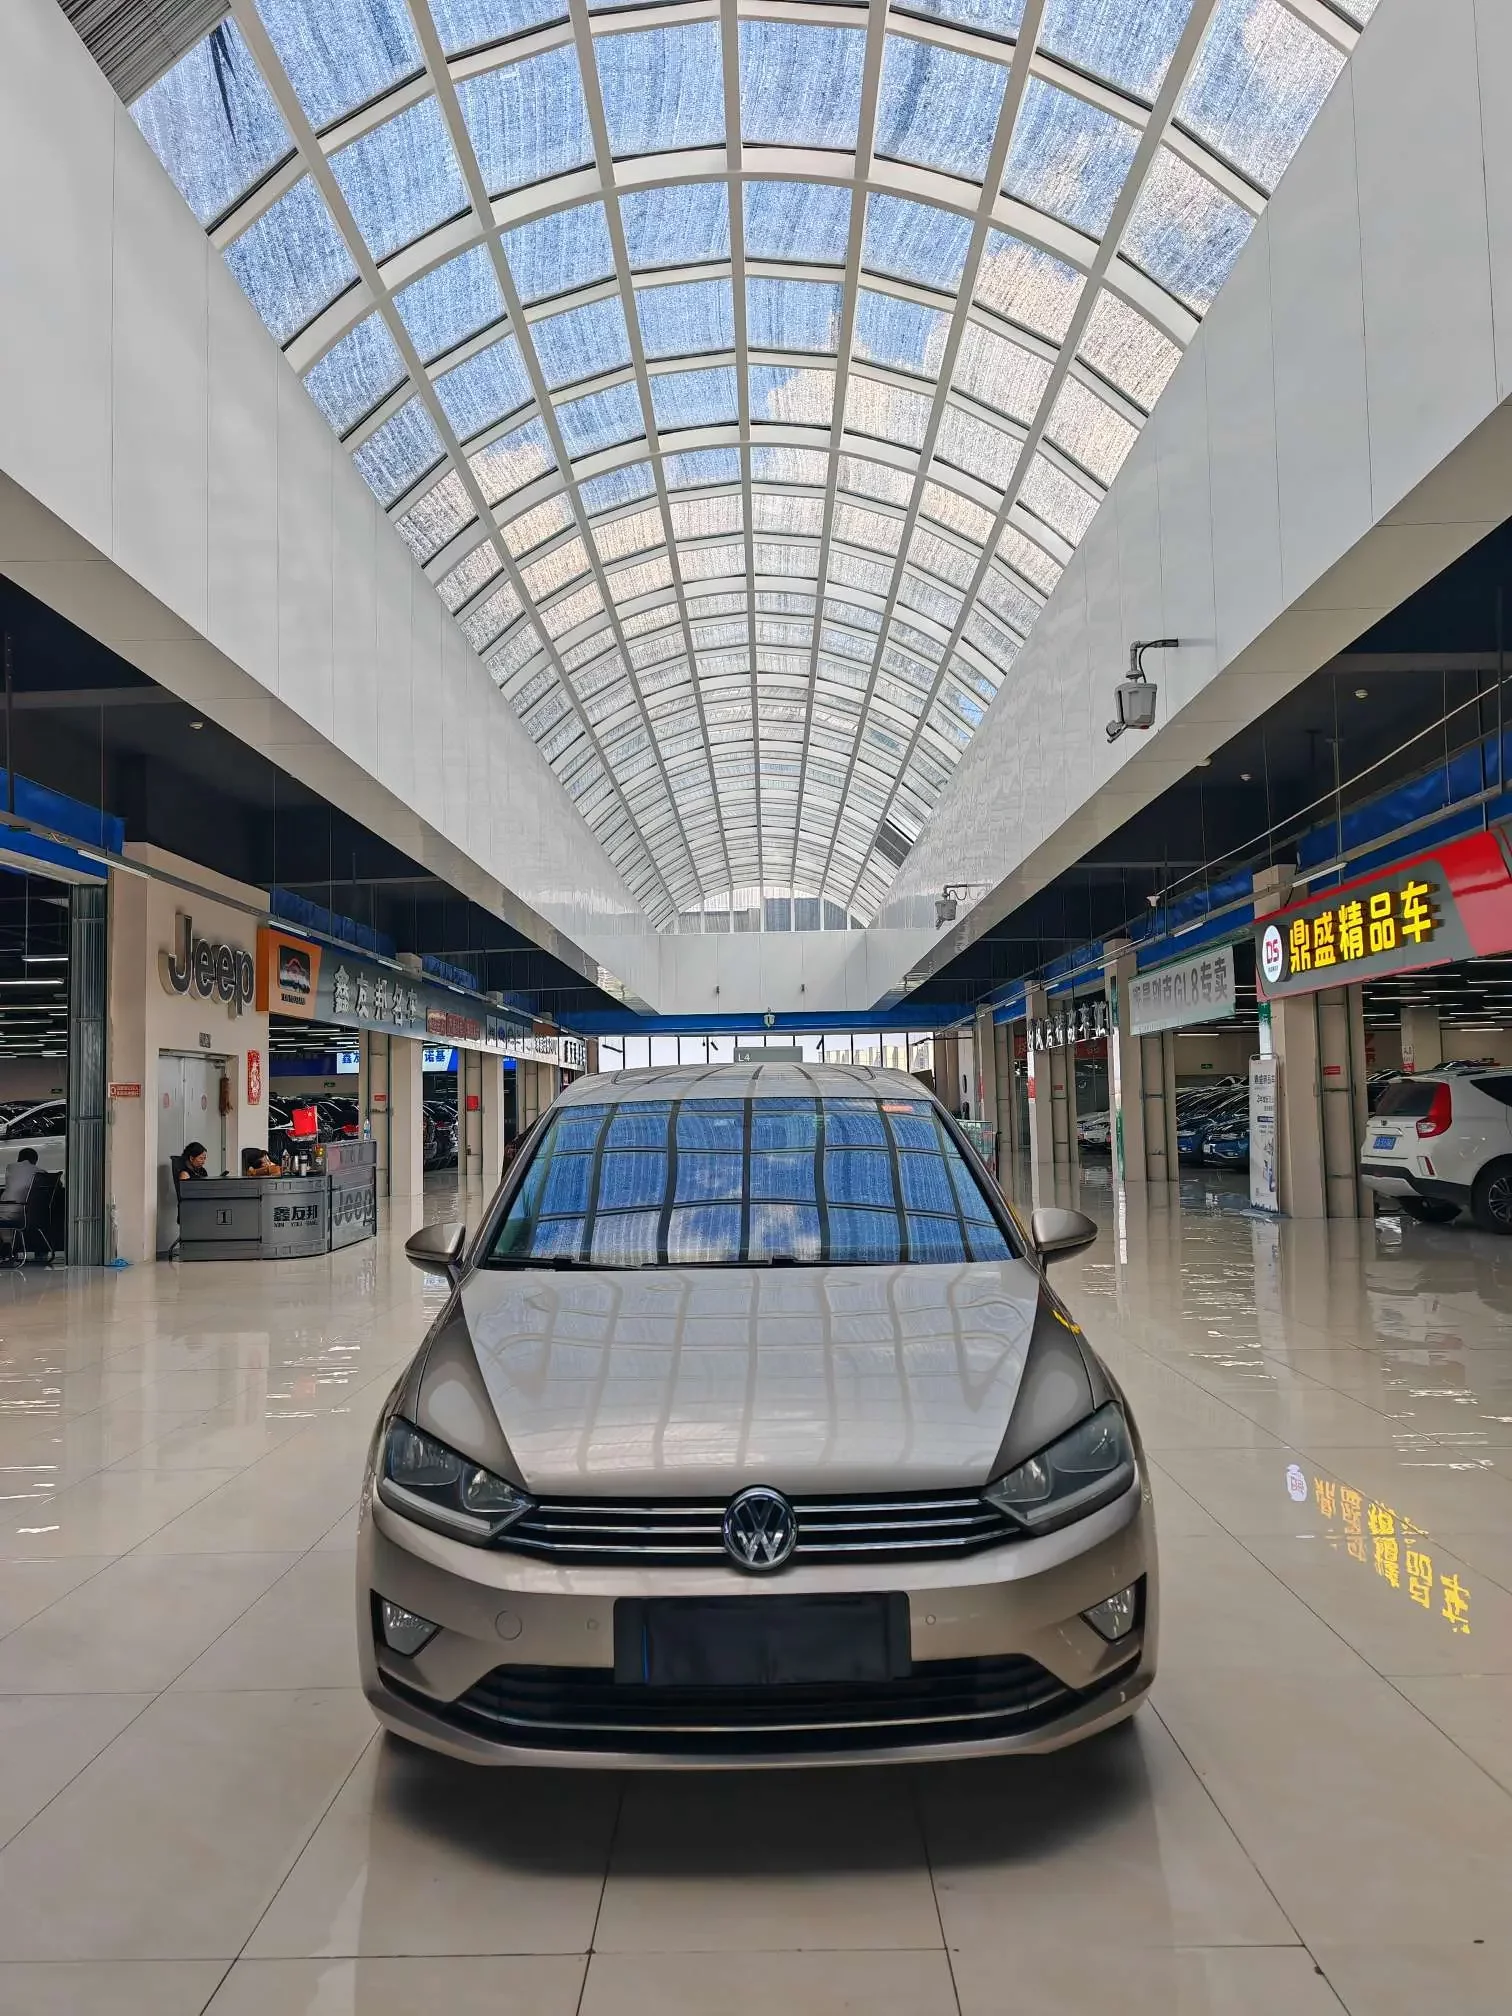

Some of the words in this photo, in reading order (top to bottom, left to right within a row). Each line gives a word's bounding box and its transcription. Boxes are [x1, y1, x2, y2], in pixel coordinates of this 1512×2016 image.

[1290, 880, 1432, 974] 鼎盛精品车
[167, 914, 255, 1018] Jeep
[738, 1053, 751, 1062] L4
[273, 1204, 318, 1221] 鑫友邦
